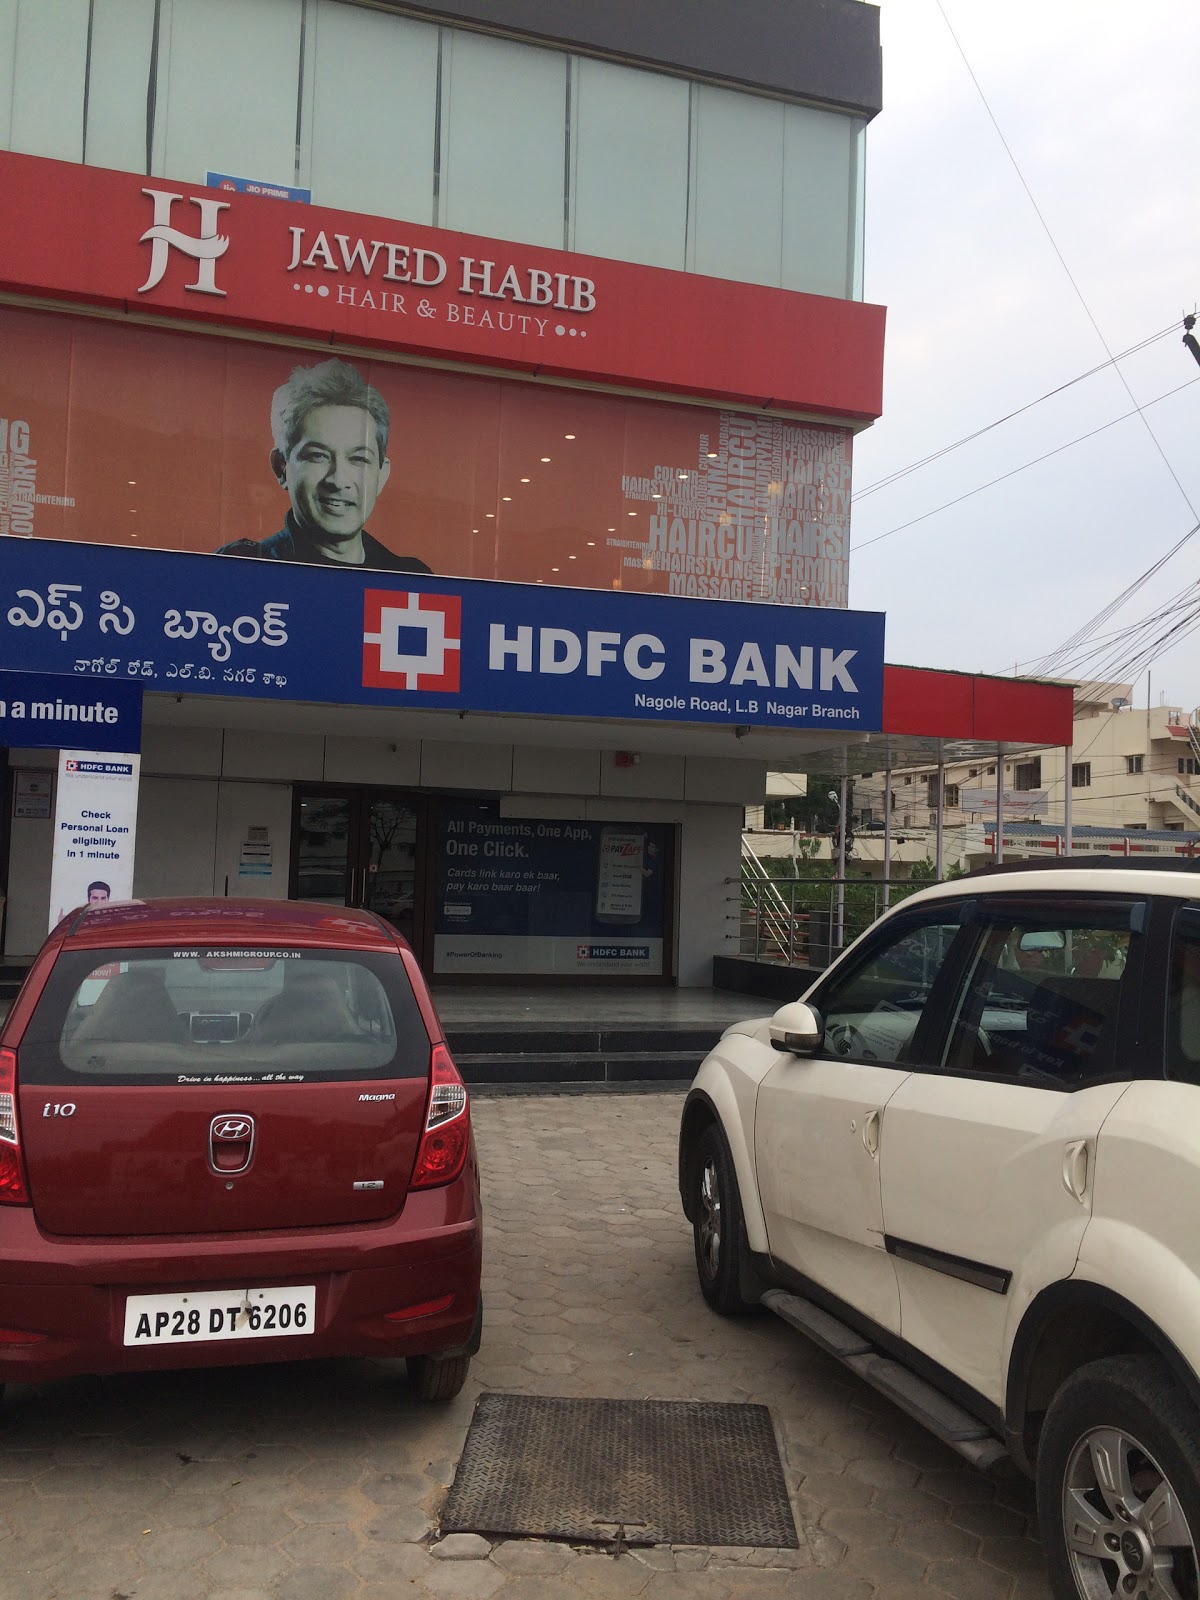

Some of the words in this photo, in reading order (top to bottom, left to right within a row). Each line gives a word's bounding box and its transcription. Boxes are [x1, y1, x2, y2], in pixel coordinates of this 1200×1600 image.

[246, 185, 260, 194] JIO
[262, 187, 289, 198] PRIME
[287, 226, 447, 287] JAWED
[459, 256, 596, 313] HABIB
[336, 285, 407, 315] HAIR
[416, 299, 436, 318] &
[447, 303, 549, 338] BEAUTY
[783, 426, 840, 447] MASSAGE
[699, 434, 709, 470] COLOUR
[783, 441, 840, 463] PERMING
[654, 465, 699, 485] COLOUR
[727, 412, 757, 526] HAIRCU
[622, 475, 699, 499] HAIRSTYLING
[706, 456, 727, 523] HENNA
[624, 556, 662, 571] MASSAGE
[642, 549, 662, 561] HEAD
[661, 551, 752, 580] HAIRSTYLING
[669, 573, 752, 601] MASSAGE
[768, 577, 849, 603] HAIRSTYLIN
[164, 602, 290, 662] బ్యాంక్
[488, 623, 666, 681] HDFC
[689, 638, 860, 693] BANK
[222, 668, 257, 683] నగర్
[262, 672, 288, 688] శాఖ
[11, 701, 26, 719] a
[31, 698, 119, 724] minute
[634, 693, 686, 711] Nagole
[690, 696, 731, 714] Road,
[735, 699, 759, 714] L.B
[766, 701, 809, 718] Nagar
[811, 703, 860, 720] Branch
[80, 763, 104, 771] HDFC
[105, 765, 129, 773] BANK
[81, 810, 111, 819] Check
[61, 822, 103, 832] Personal
[106, 825, 129, 833] Loan
[447, 820, 464, 833] All
[468, 821, 535, 838] Payments,
[537, 824, 561, 837] One
[563, 825, 592, 841] App,
[72, 837, 117, 848] eligibility
[446, 839, 479, 856] One
[483, 840, 529, 858] Click.
[67, 849, 76, 858] in
[79, 850, 84, 858] 1
[87, 851, 120, 860] minute
[447, 867, 477, 878] Cards
[479, 868, 498, 879] link
[499, 869, 521, 879] karo
[523, 870, 535, 880] ek
[537, 871, 561, 882] baar,
[446, 882, 465, 892] pay
[467, 882, 489, 891] karo
[491, 883, 514, 892] baar
[515, 883, 542, 893] baar!
[593, 948, 618, 956] HDFC
[620, 948, 646, 957] BANK
[177, 1075, 201, 1083] Drive
[262, 1073, 273, 1081] all
[275, 1073, 286, 1081] the
[288, 1074, 304, 1082] way
[358, 1092, 396, 1103] Magna
[42, 1102, 76, 1118] i10
[134, 1310, 200, 1338] AP28
[209, 1307, 245, 1333] DT
[248, 1303, 307, 1330] 6206
